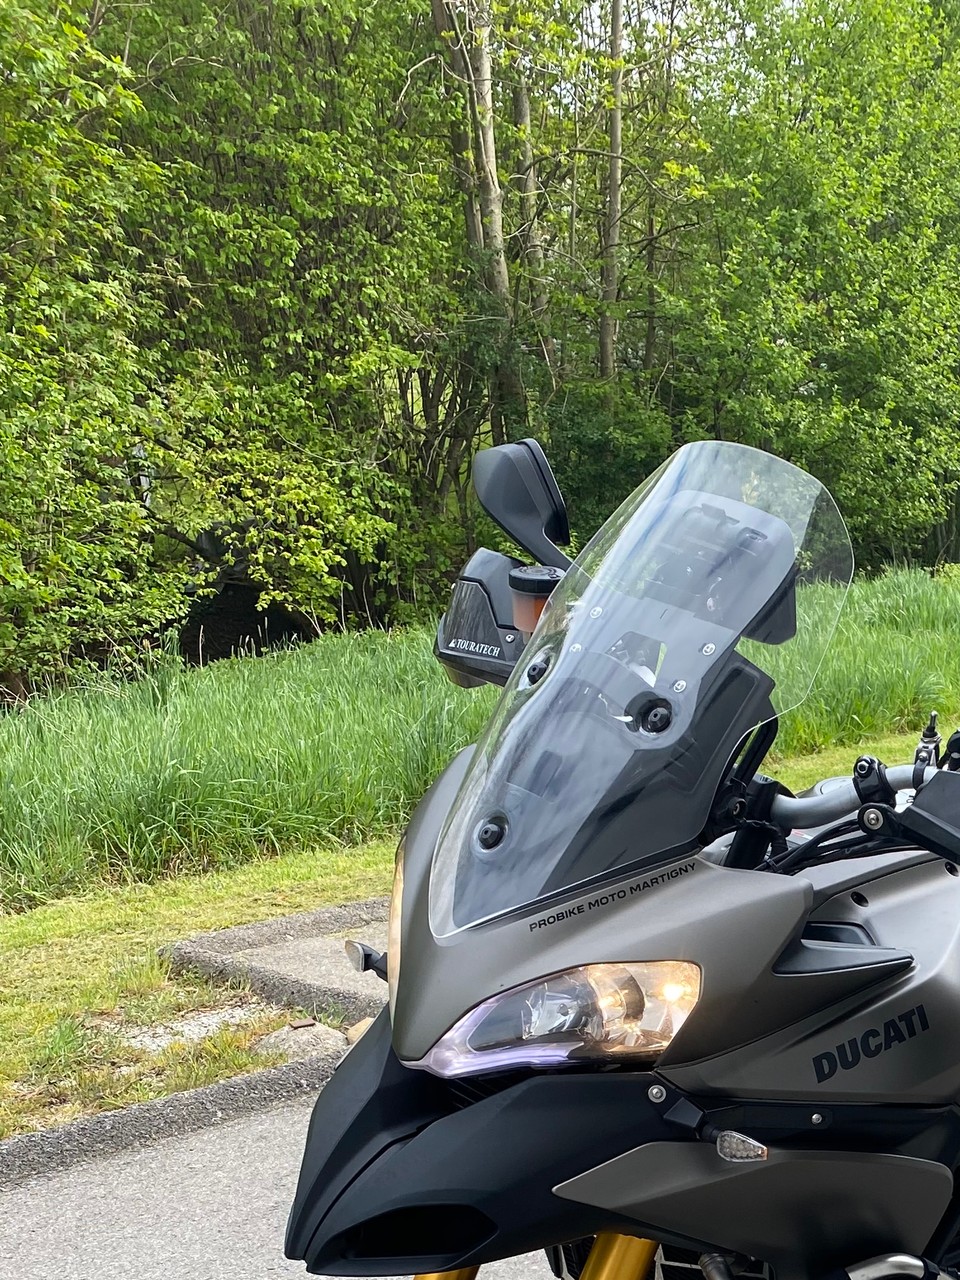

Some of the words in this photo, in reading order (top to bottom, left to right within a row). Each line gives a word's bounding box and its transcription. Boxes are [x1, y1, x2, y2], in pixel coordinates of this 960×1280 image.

[456, 639, 501, 657] TOURATECH
[529, 904, 585, 932] PROBIKE
[588, 889, 627, 911] MOTO
[629, 862, 696, 896] MARTIGNY
[812, 1003, 930, 1084] DUCATI
